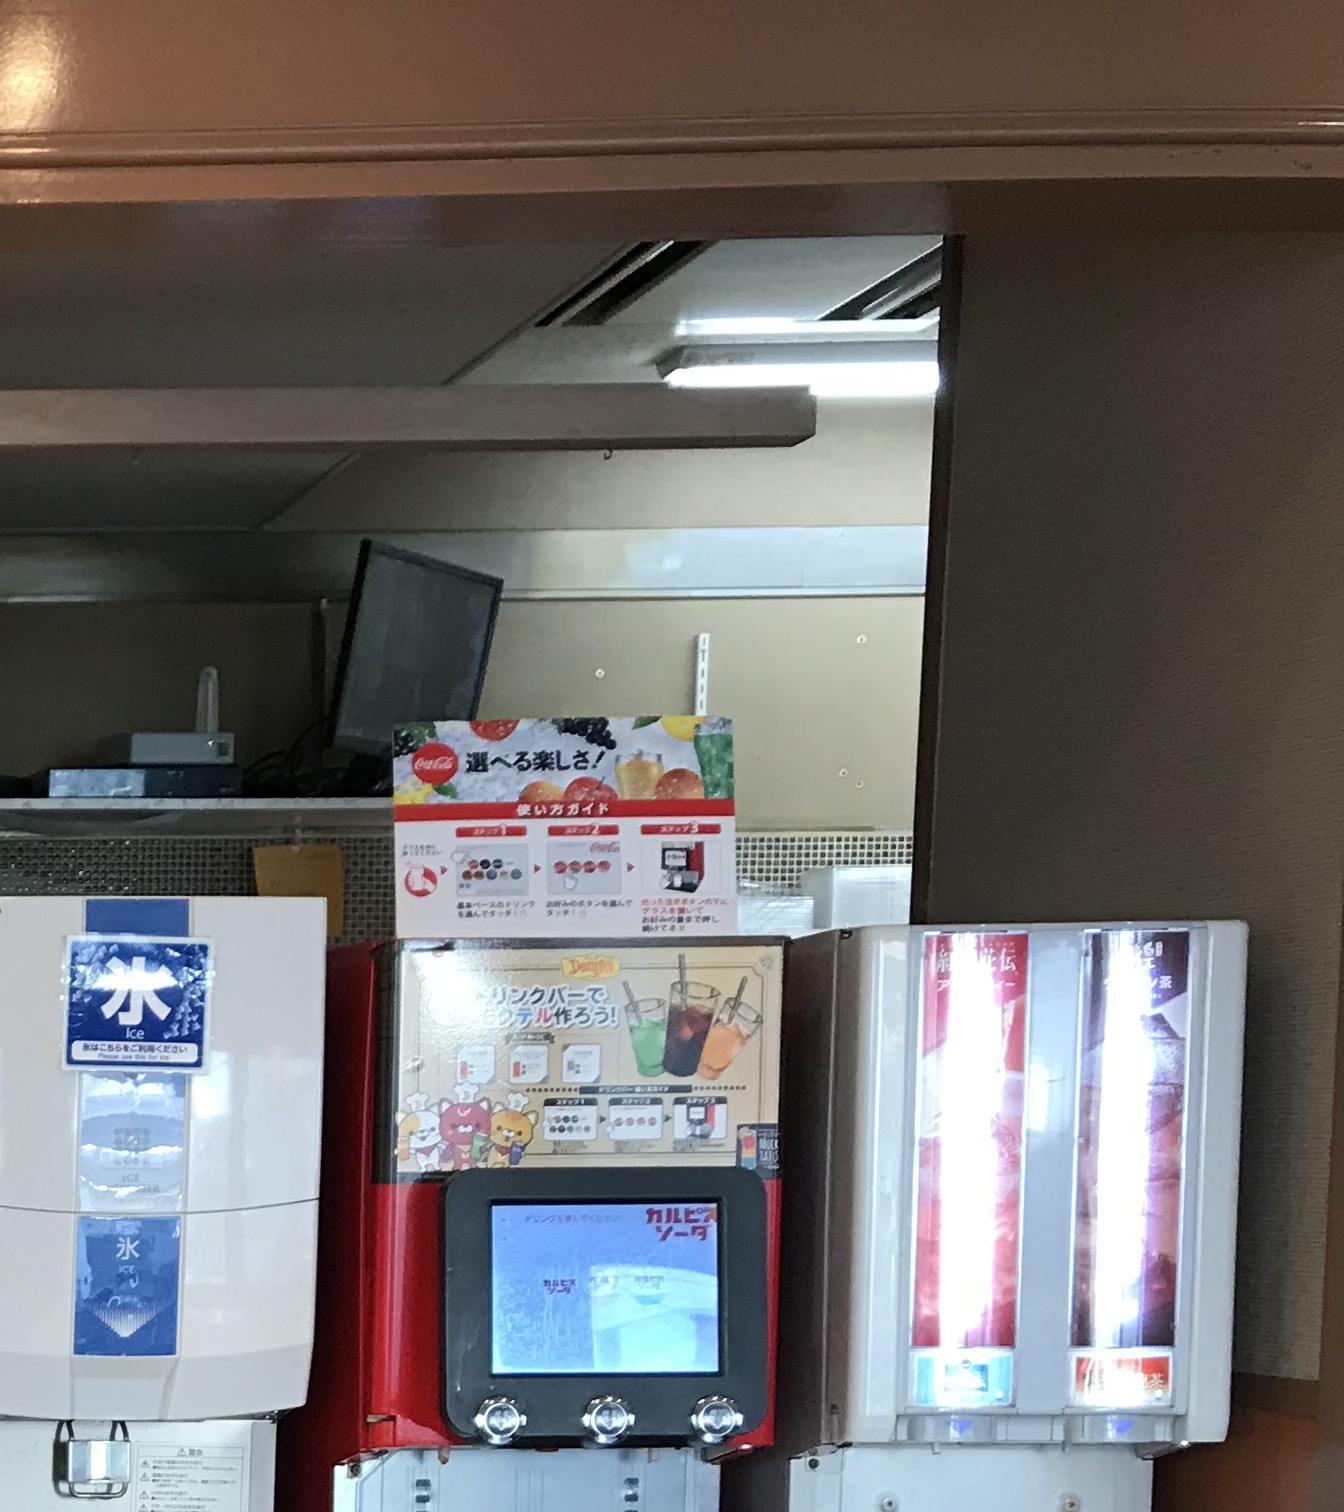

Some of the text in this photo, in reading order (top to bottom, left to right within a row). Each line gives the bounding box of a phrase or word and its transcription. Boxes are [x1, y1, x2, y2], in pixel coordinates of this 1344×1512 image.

[517, 803, 609, 816] 使い方ガイド
[101, 956, 175, 1025] 氷
[477, 987, 604, 1005] リンクバーで
[126, 1027, 145, 1039] Ice
[83, 1043, 187, 1053] 氷はこちらをご利用ください
[646, 1207, 717, 1224] カルピス
[116, 1236, 140, 1260] 氷
[119, 1265, 135, 1273] ICE
